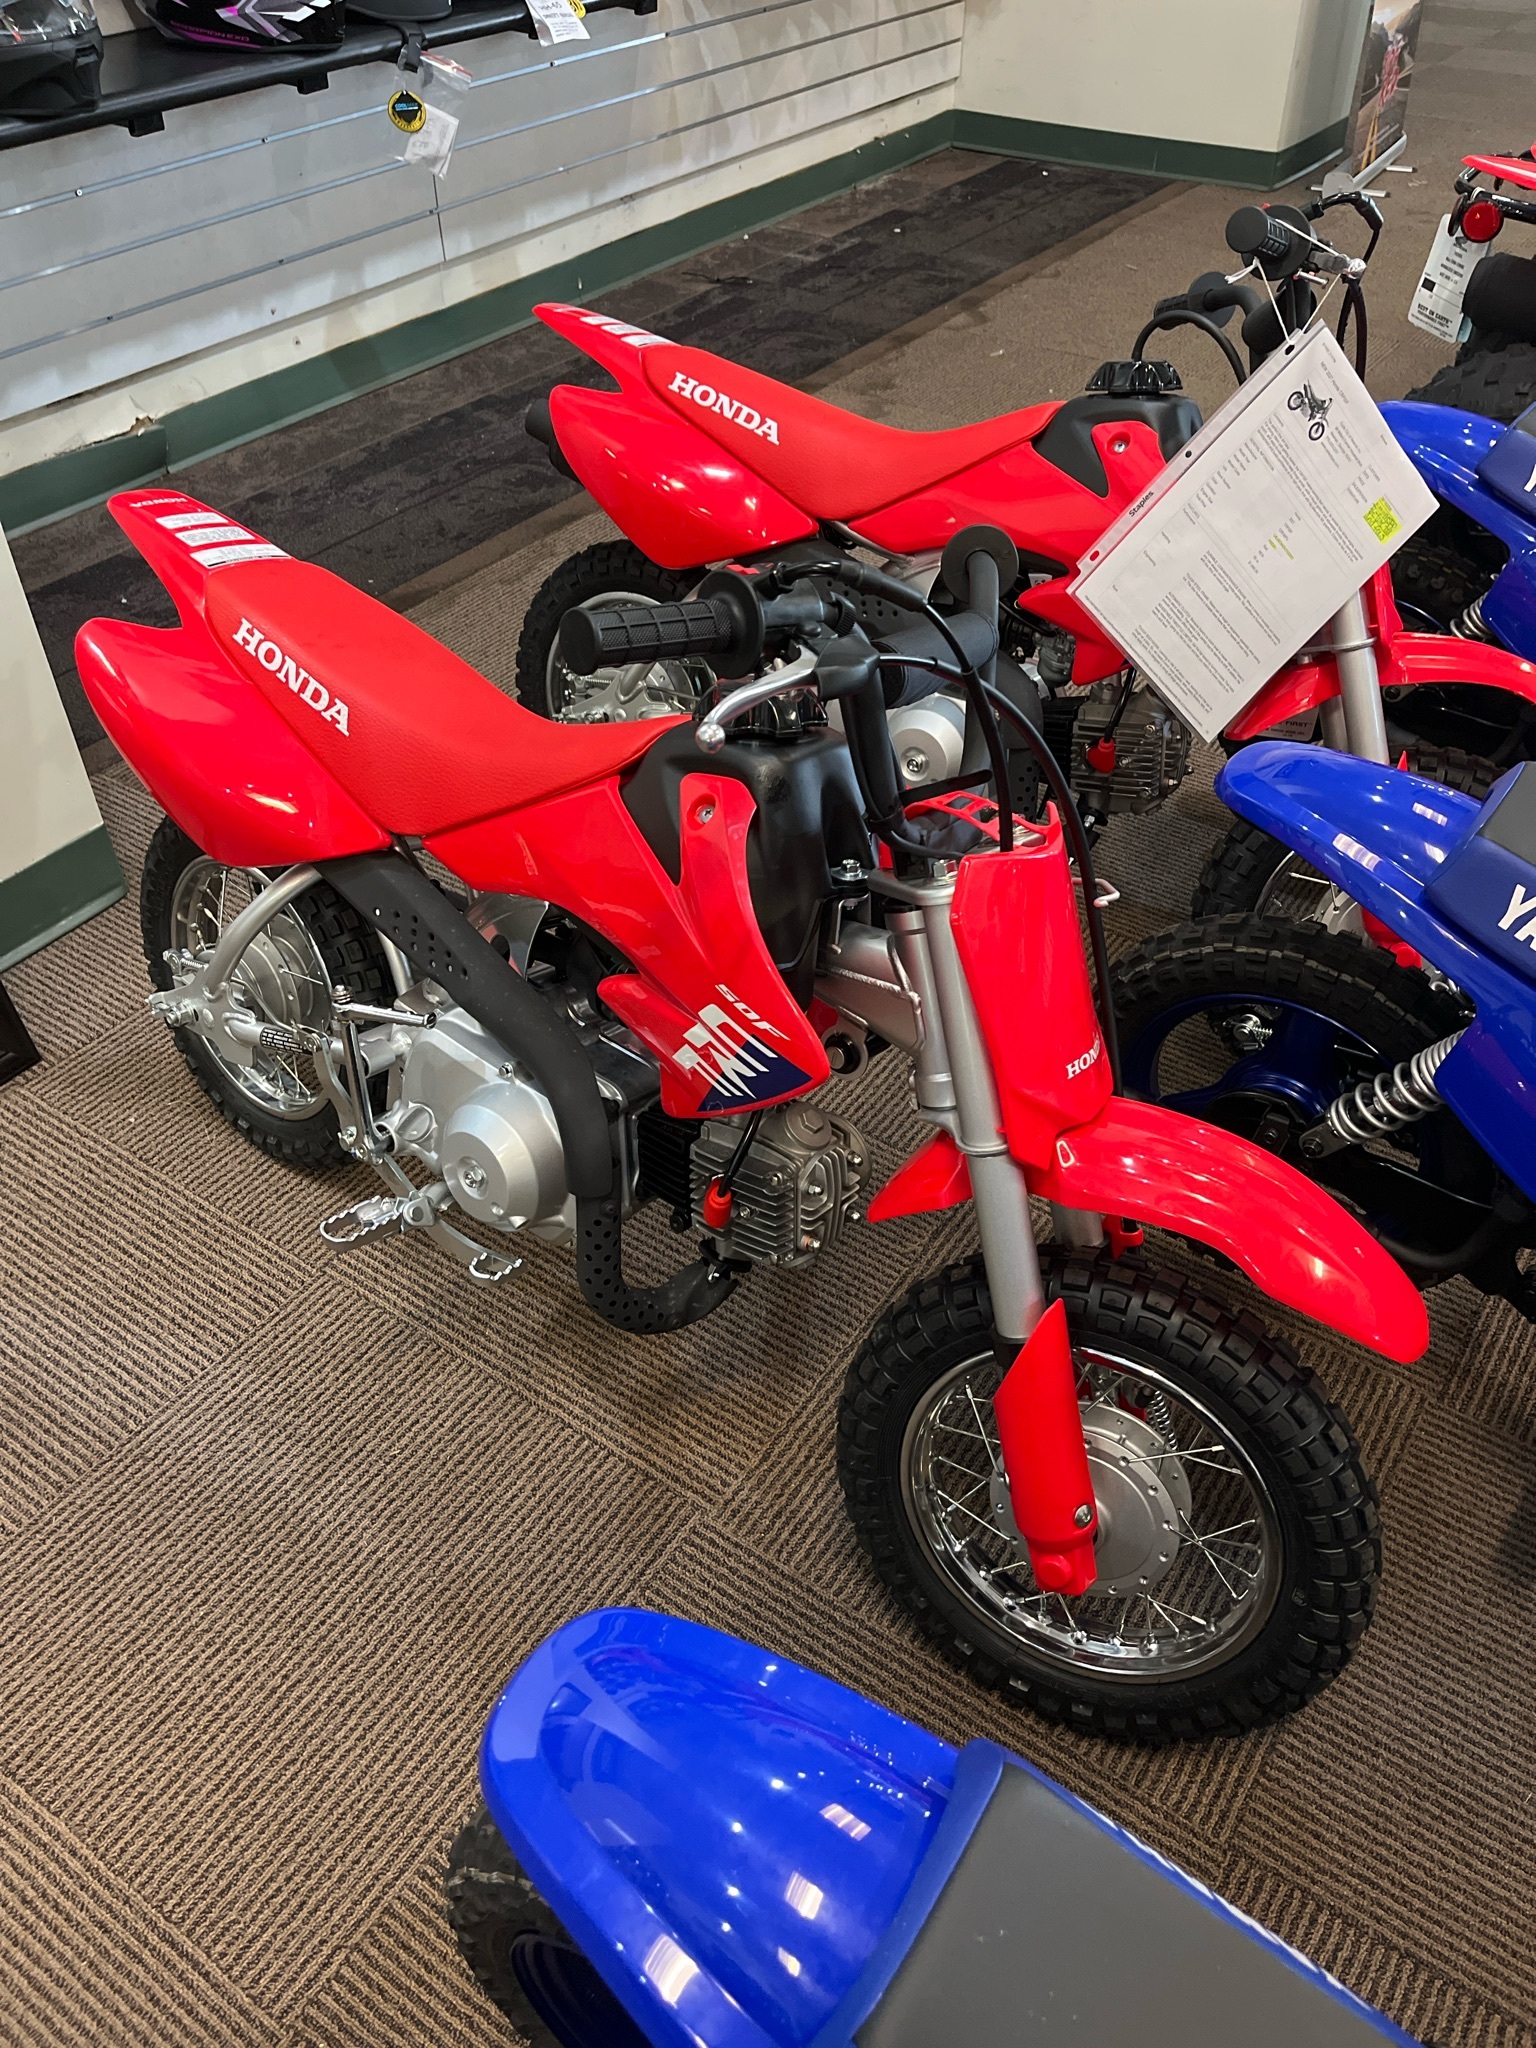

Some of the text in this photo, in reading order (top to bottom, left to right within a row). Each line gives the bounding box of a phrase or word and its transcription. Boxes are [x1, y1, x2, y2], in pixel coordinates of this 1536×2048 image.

[667, 371, 780, 446] HONDA
[1128, 490, 1155, 518] Staples
[231, 617, 350, 737] HONDA
[715, 983, 791, 1041] 50F
